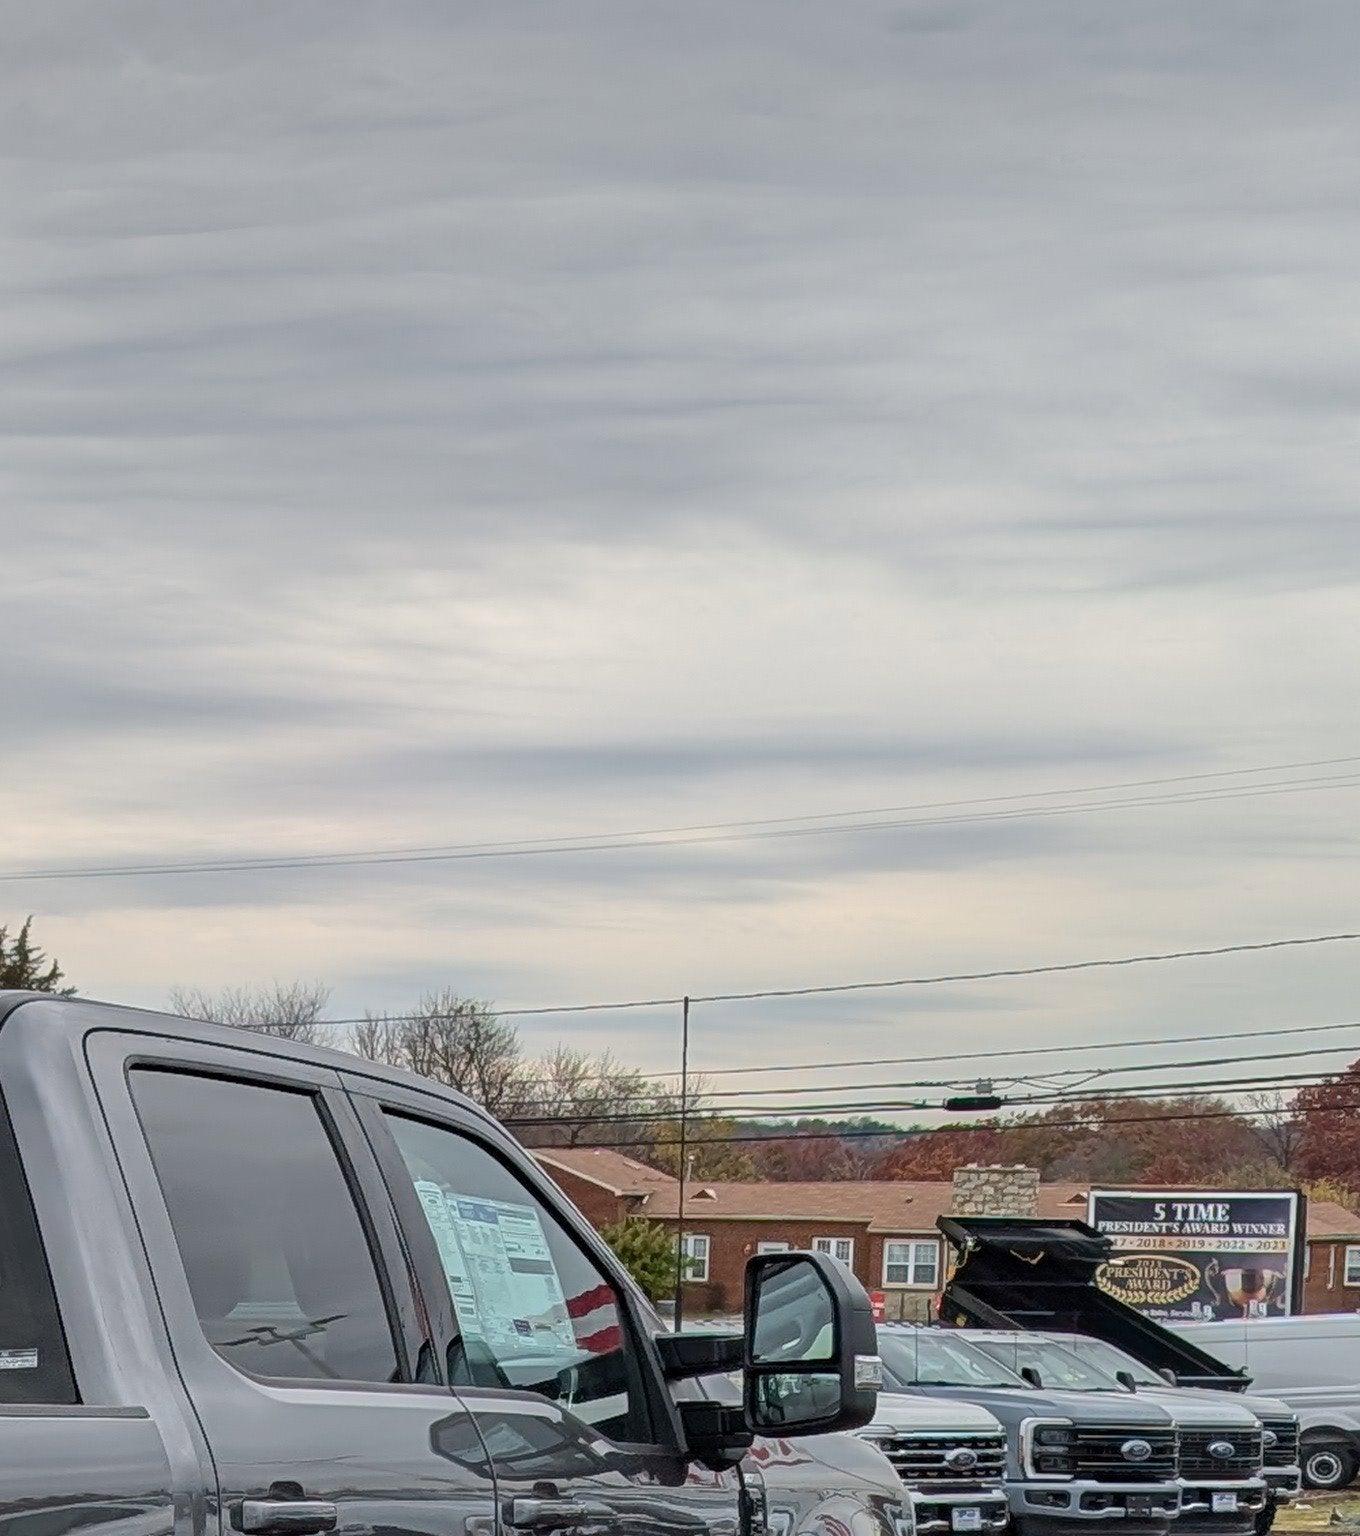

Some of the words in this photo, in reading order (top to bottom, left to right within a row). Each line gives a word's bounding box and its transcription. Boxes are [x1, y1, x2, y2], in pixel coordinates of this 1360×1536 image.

[1152, 1203, 1167, 1221] 5
[1171, 1203, 1231, 1222] TIME
[1096, 1221, 1180, 1234] PRESIDENT'S
[1181, 1222, 1231, 1235] AWARD
[1231, 1223, 1287, 1237] WINNER
[1135, 1238, 1166, 1249] 2018
[1176, 1239, 1206, 1250] 2019
